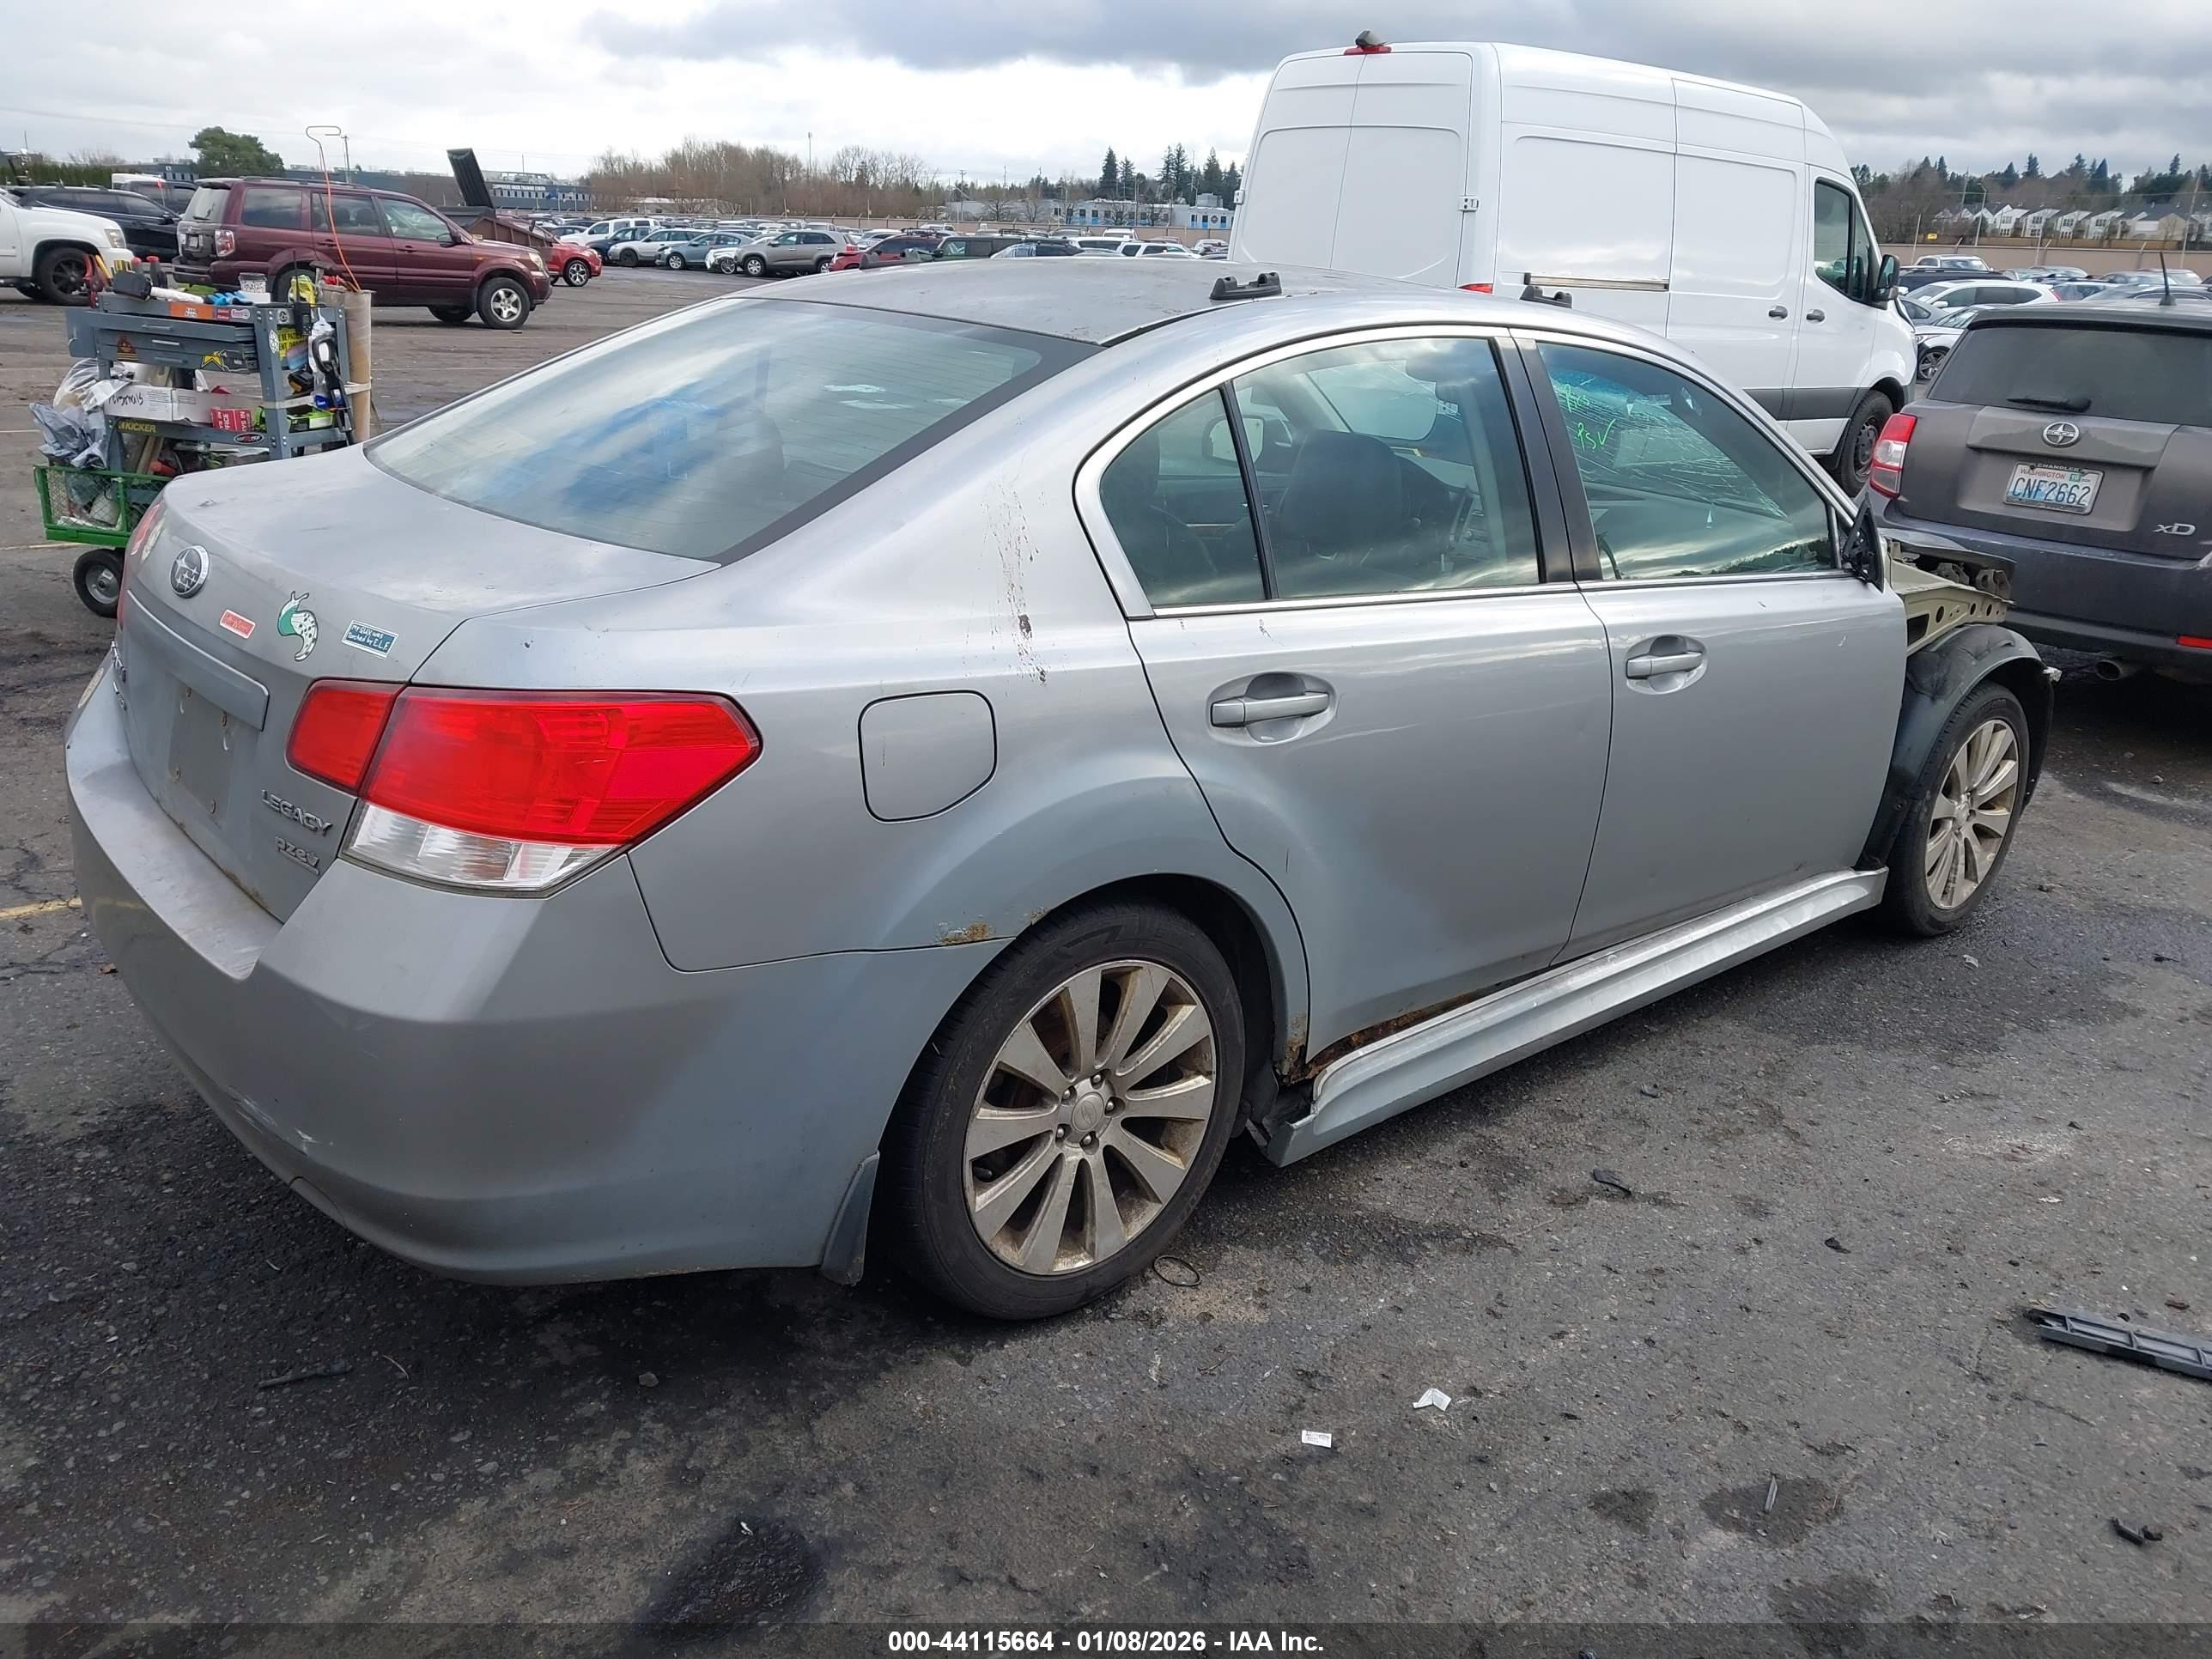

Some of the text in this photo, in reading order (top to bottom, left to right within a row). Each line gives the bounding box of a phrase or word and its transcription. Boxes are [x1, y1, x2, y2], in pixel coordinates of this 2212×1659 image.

[125, 422, 156, 433] KICKER
[2037, 463, 2080, 472] CHANDLER
[2021, 468, 2067, 480] WASHINGTON
[2013, 477, 2091, 507] CNF2662
[2154, 522, 2197, 537] xD
[359, 626, 372, 636] SUV
[261, 789, 334, 836] LEGACY
